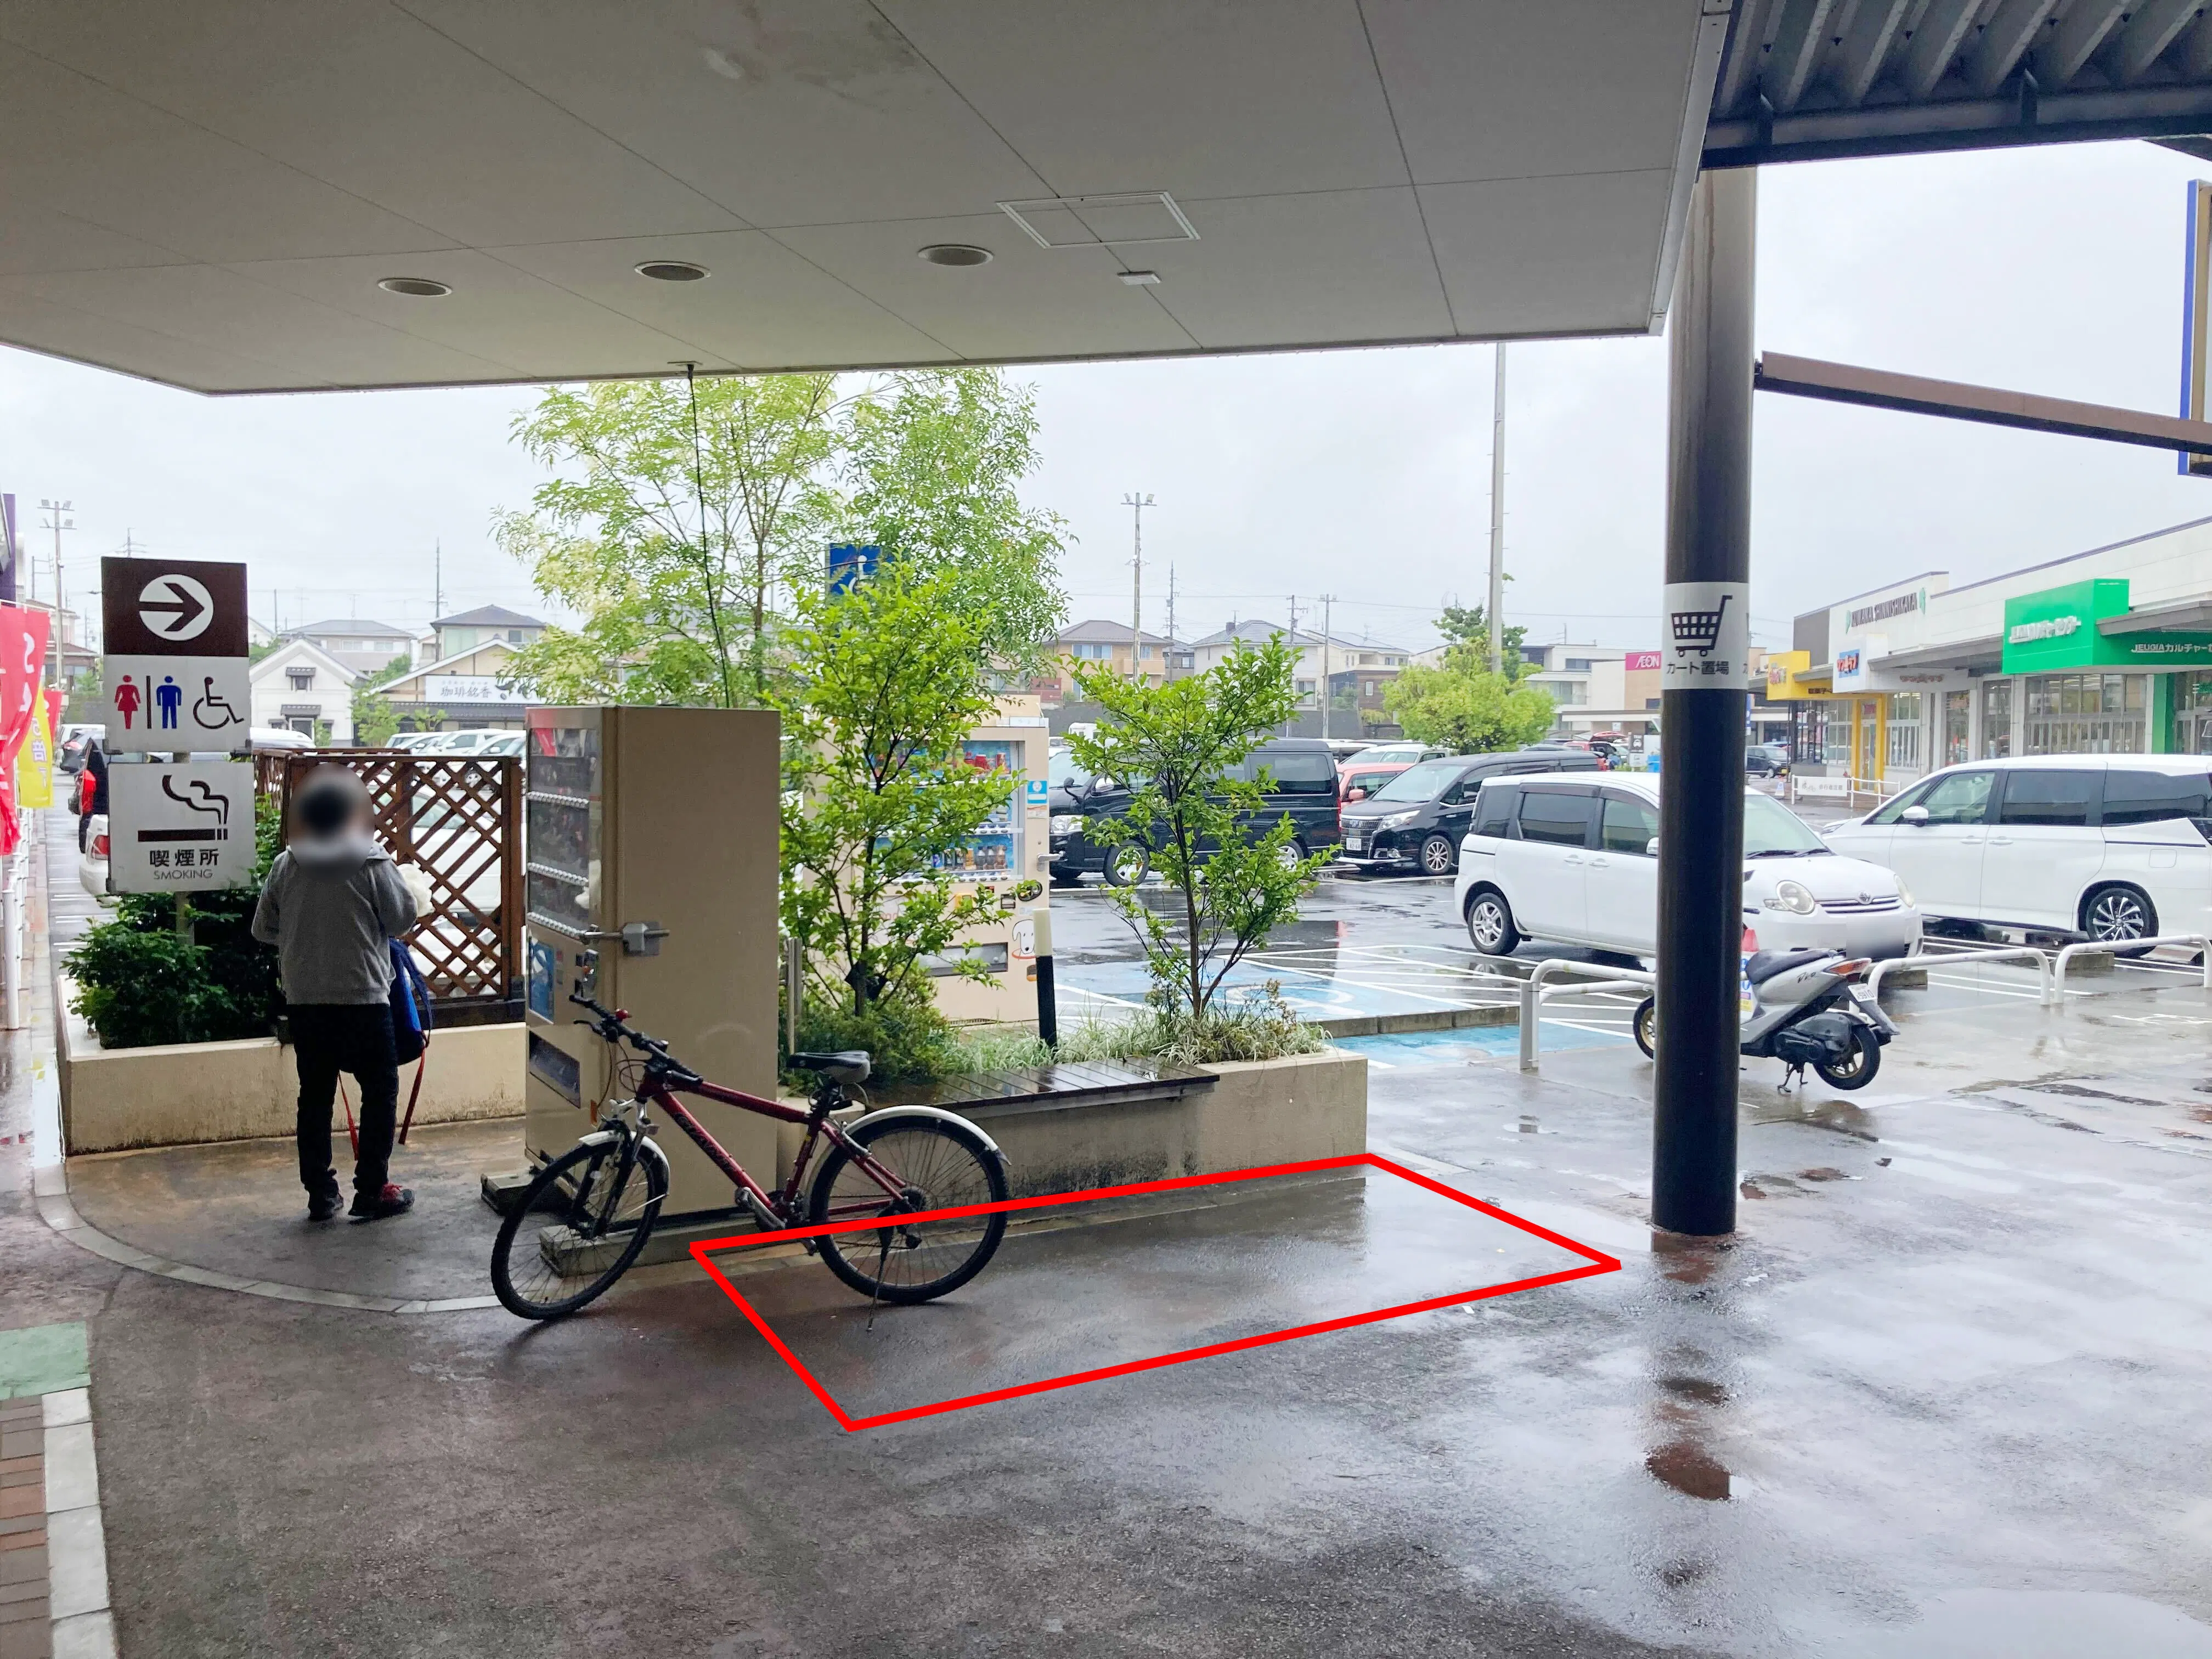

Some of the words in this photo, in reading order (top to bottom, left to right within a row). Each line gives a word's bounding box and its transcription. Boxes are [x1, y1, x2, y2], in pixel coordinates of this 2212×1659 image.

[1666, 661, 1729, 675] カート置場
[149, 849, 219, 867] 喫煙所
[153, 869, 213, 880] SMOKING
